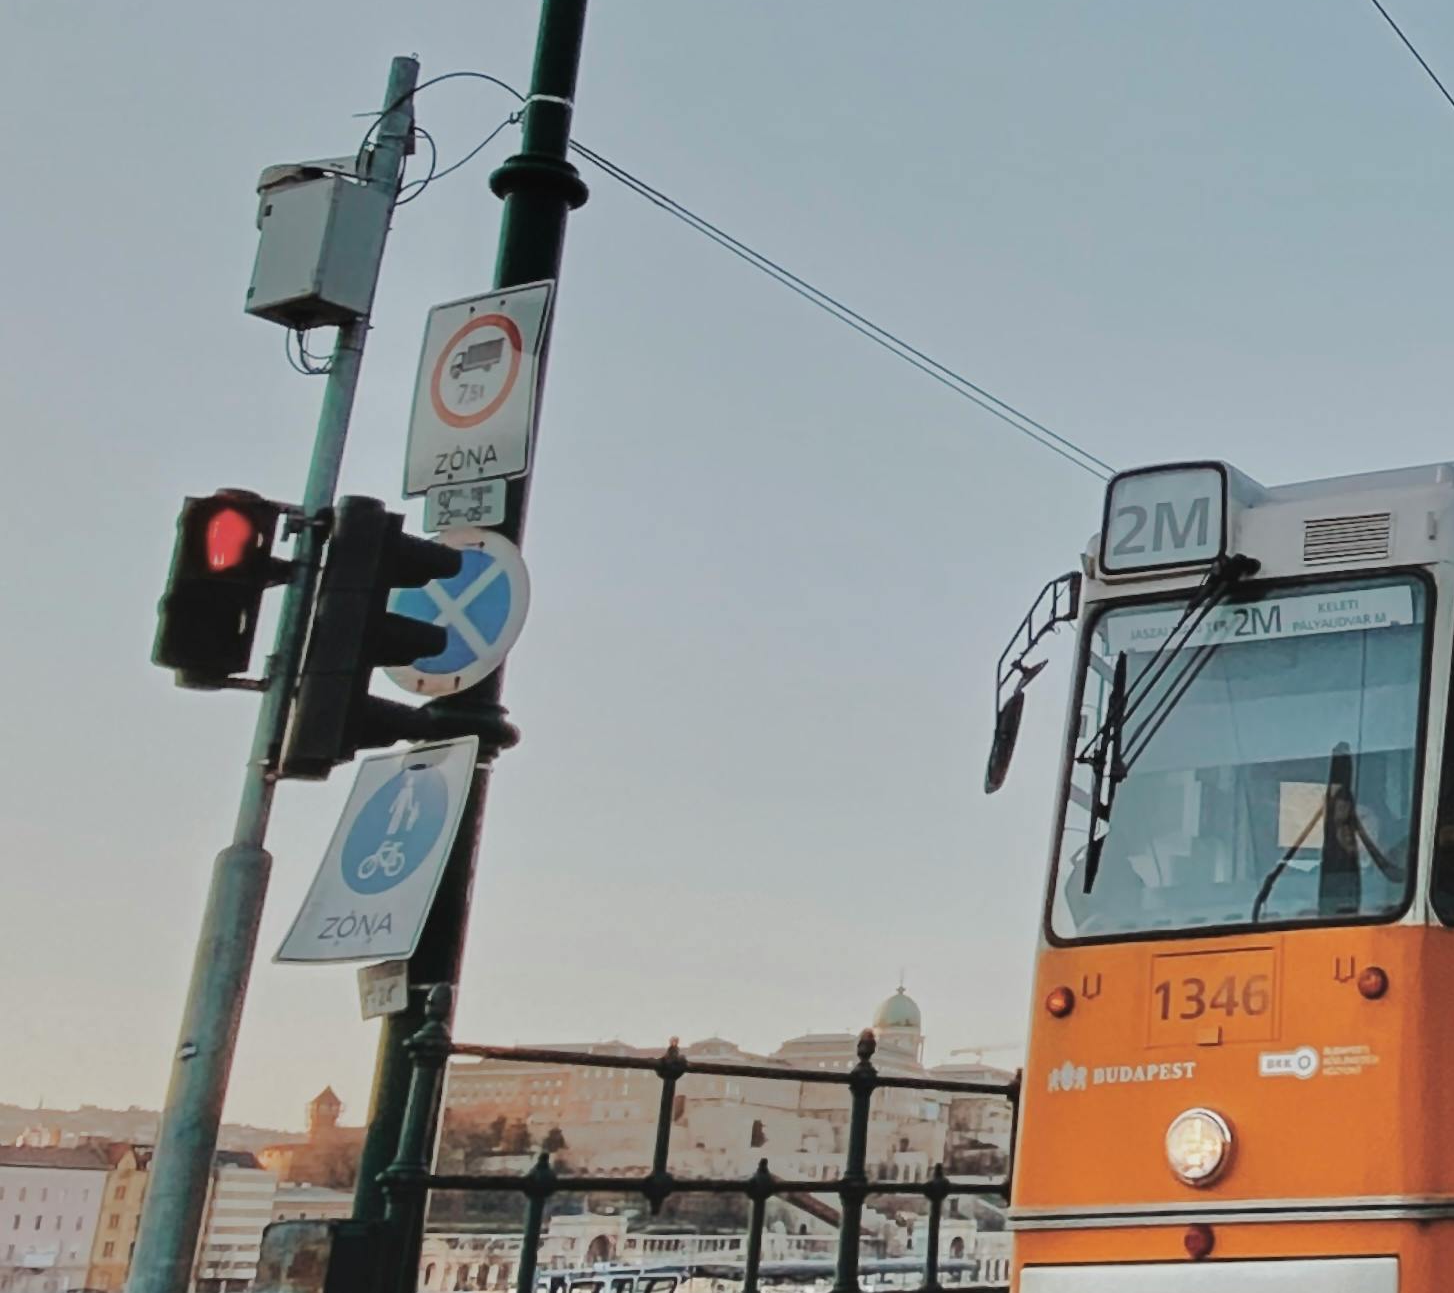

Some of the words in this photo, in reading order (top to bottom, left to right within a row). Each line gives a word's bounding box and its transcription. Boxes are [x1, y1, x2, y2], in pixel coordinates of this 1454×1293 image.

[434, 444, 498, 475] ZÓNA
[1112, 497, 1210, 556] 2M
[1233, 605, 1282, 637] 2M
[317, 909, 393, 940] ZÓNA
[1154, 974, 1271, 1021] 1346
[1092, 1061, 1197, 1085] BUDAPEST
